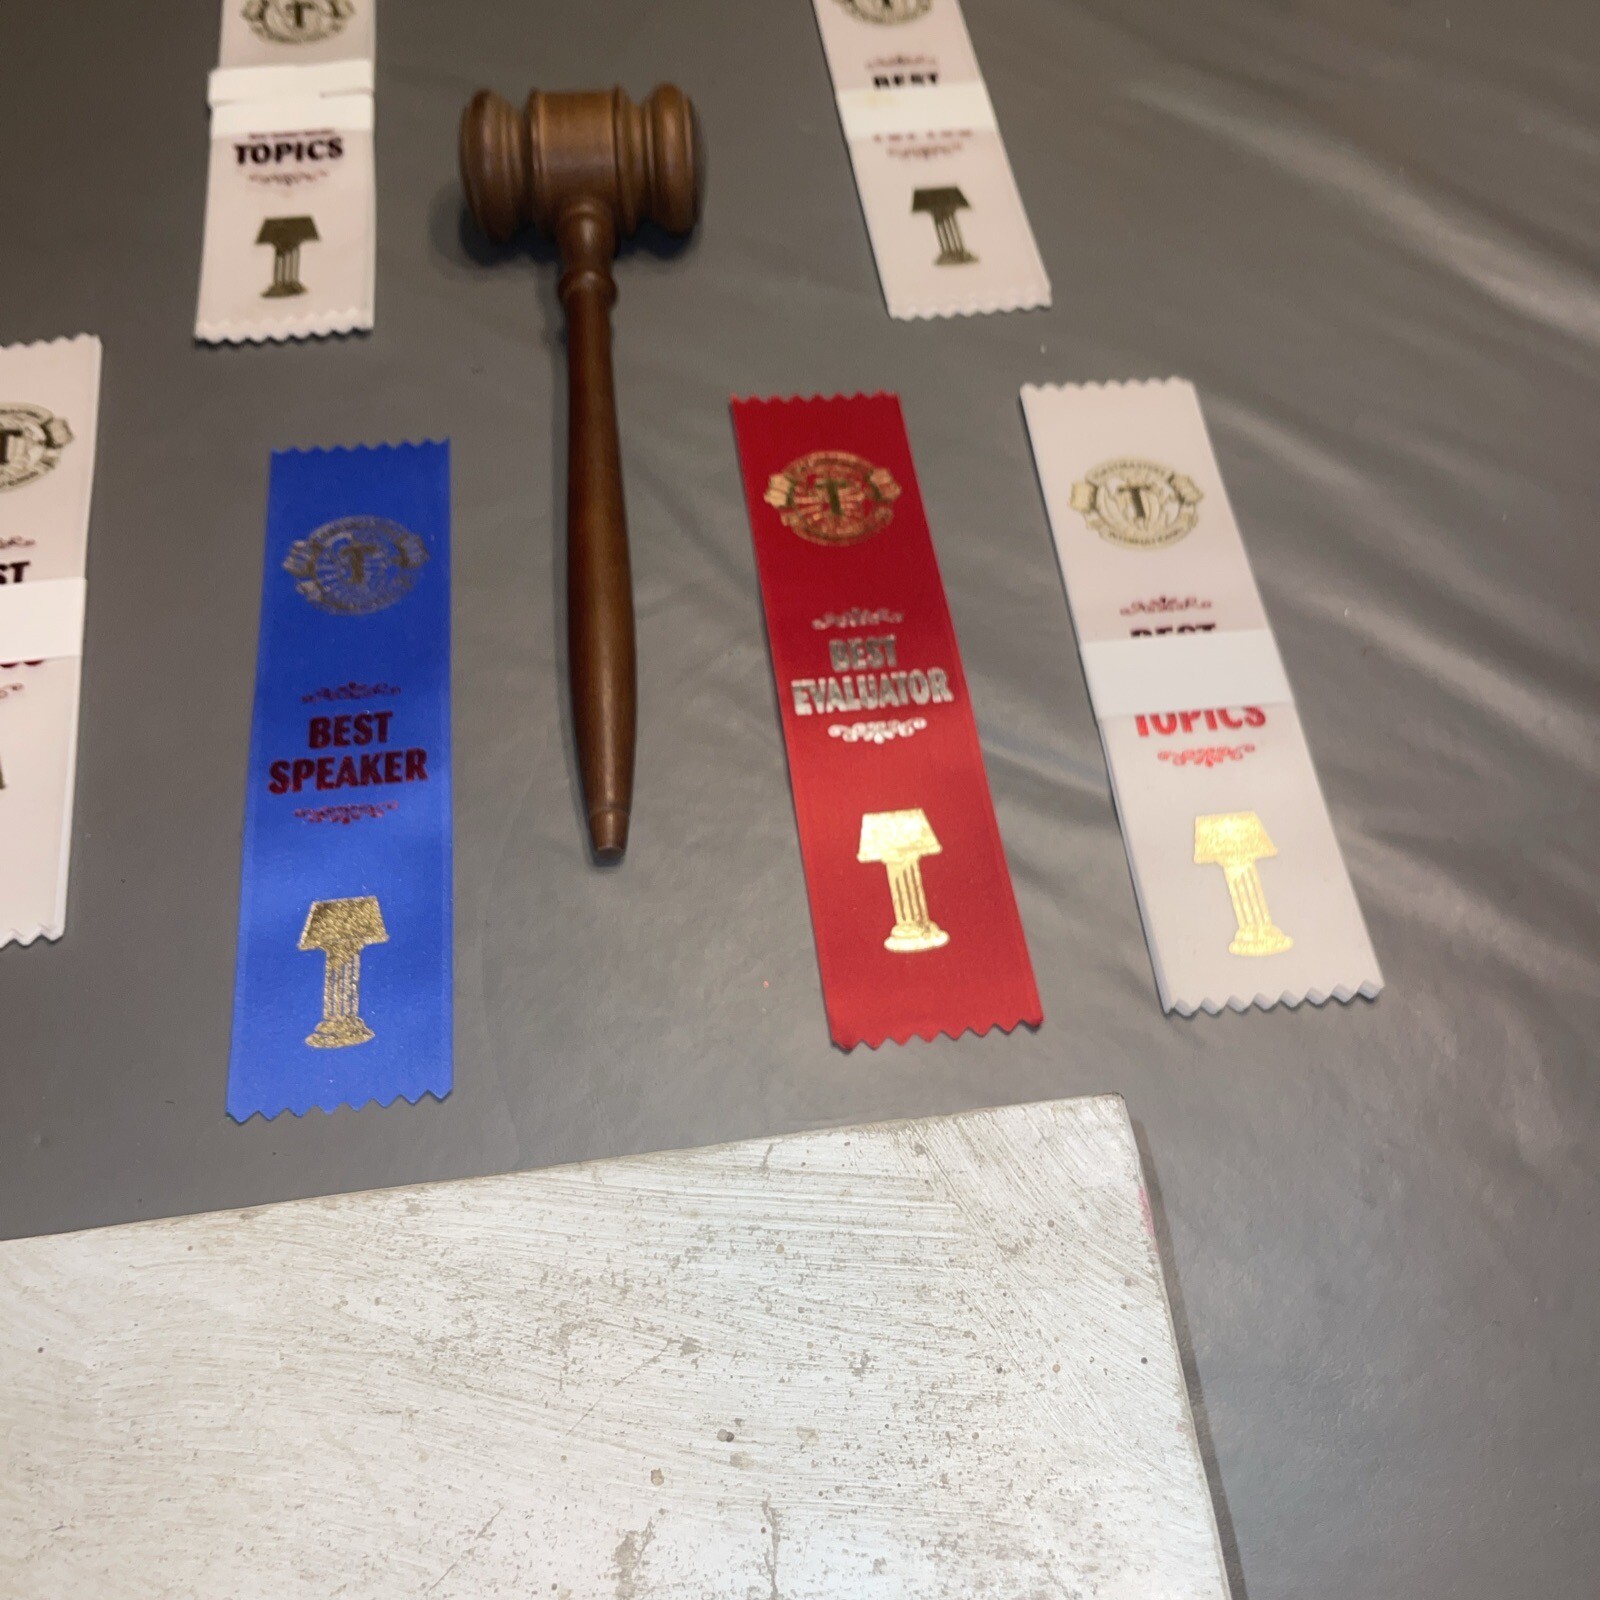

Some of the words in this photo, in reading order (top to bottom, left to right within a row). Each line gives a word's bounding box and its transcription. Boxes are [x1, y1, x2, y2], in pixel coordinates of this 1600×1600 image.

[234, 137, 343, 165] TOPICS
[829, 635, 897, 672] BEST
[791, 667, 954, 716] EVALUATOR
[309, 711, 393, 749] BEST
[268, 747, 429, 794] SPEAKER
